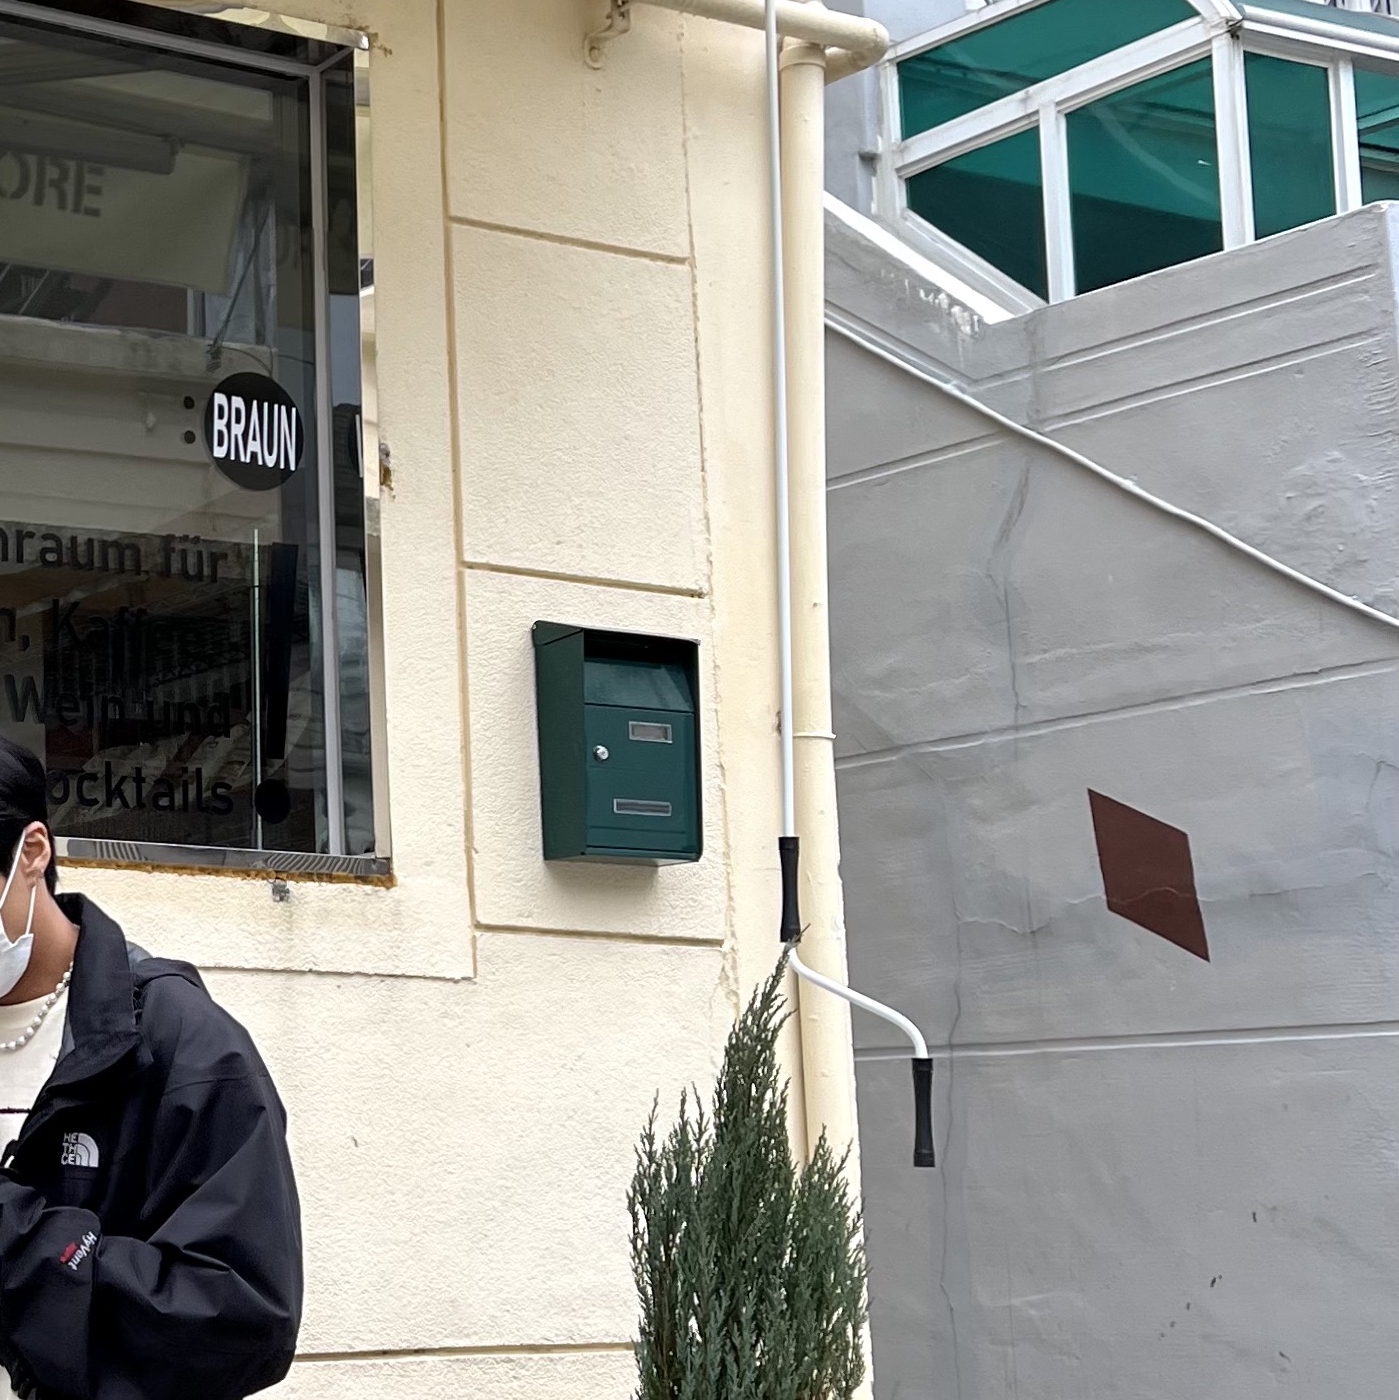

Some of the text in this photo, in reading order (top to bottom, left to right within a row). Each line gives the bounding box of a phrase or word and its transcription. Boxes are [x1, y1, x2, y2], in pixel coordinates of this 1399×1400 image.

[212, 391, 298, 472] BRAUN
[161, 534, 228, 583] für
[147, 691, 231, 738] und
[46, 760, 233, 815] ocktails
[67, 1231, 97, 1270] HyVent
